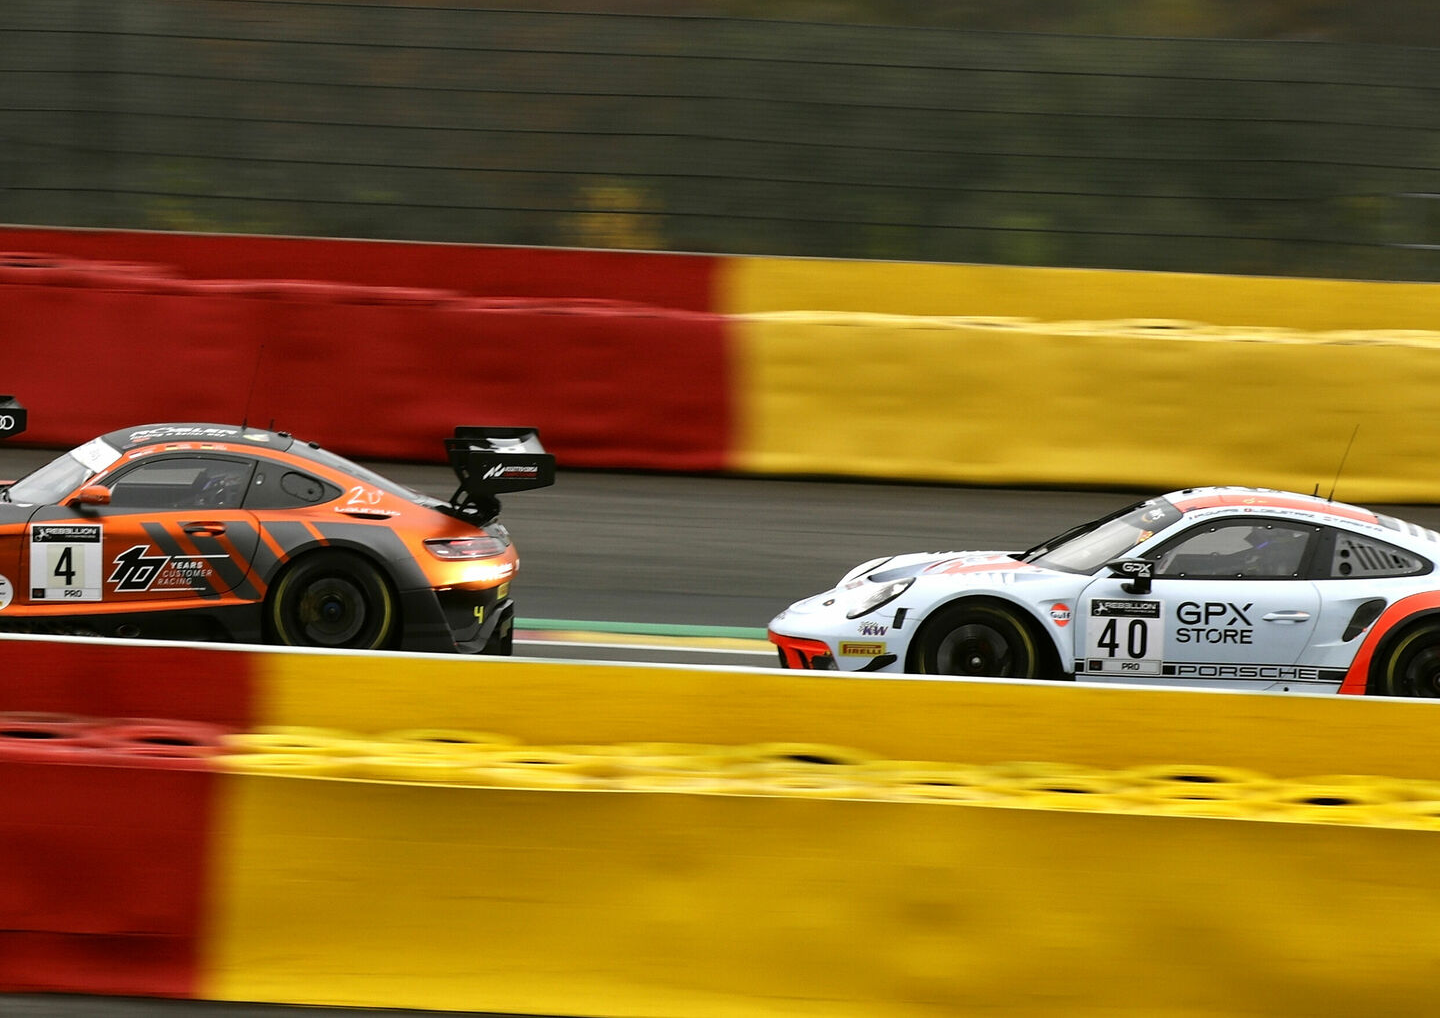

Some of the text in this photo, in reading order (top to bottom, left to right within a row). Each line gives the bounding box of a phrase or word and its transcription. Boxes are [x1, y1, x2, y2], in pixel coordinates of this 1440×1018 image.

[54, 546, 76, 586] 4
[170, 561, 203, 570] YEARS
[1122, 562, 1153, 573] GPX
[162, 569, 213, 578] CUSTOMER
[157, 577, 192, 585] RACING
[64, 589, 82, 598] PRO
[473, 605, 484, 624] 4
[1050, 611, 1071, 619] Gulf
[1176, 601, 1254, 626] GPX
[862, 625, 889, 636] KW
[1176, 628, 1254, 644] STORE
[1097, 618, 1147, 659] 40
[842, 643, 882, 655] PIRELLI
[1121, 662, 1140, 671] PRO
[1177, 665, 1318, 680] PORSCHE
